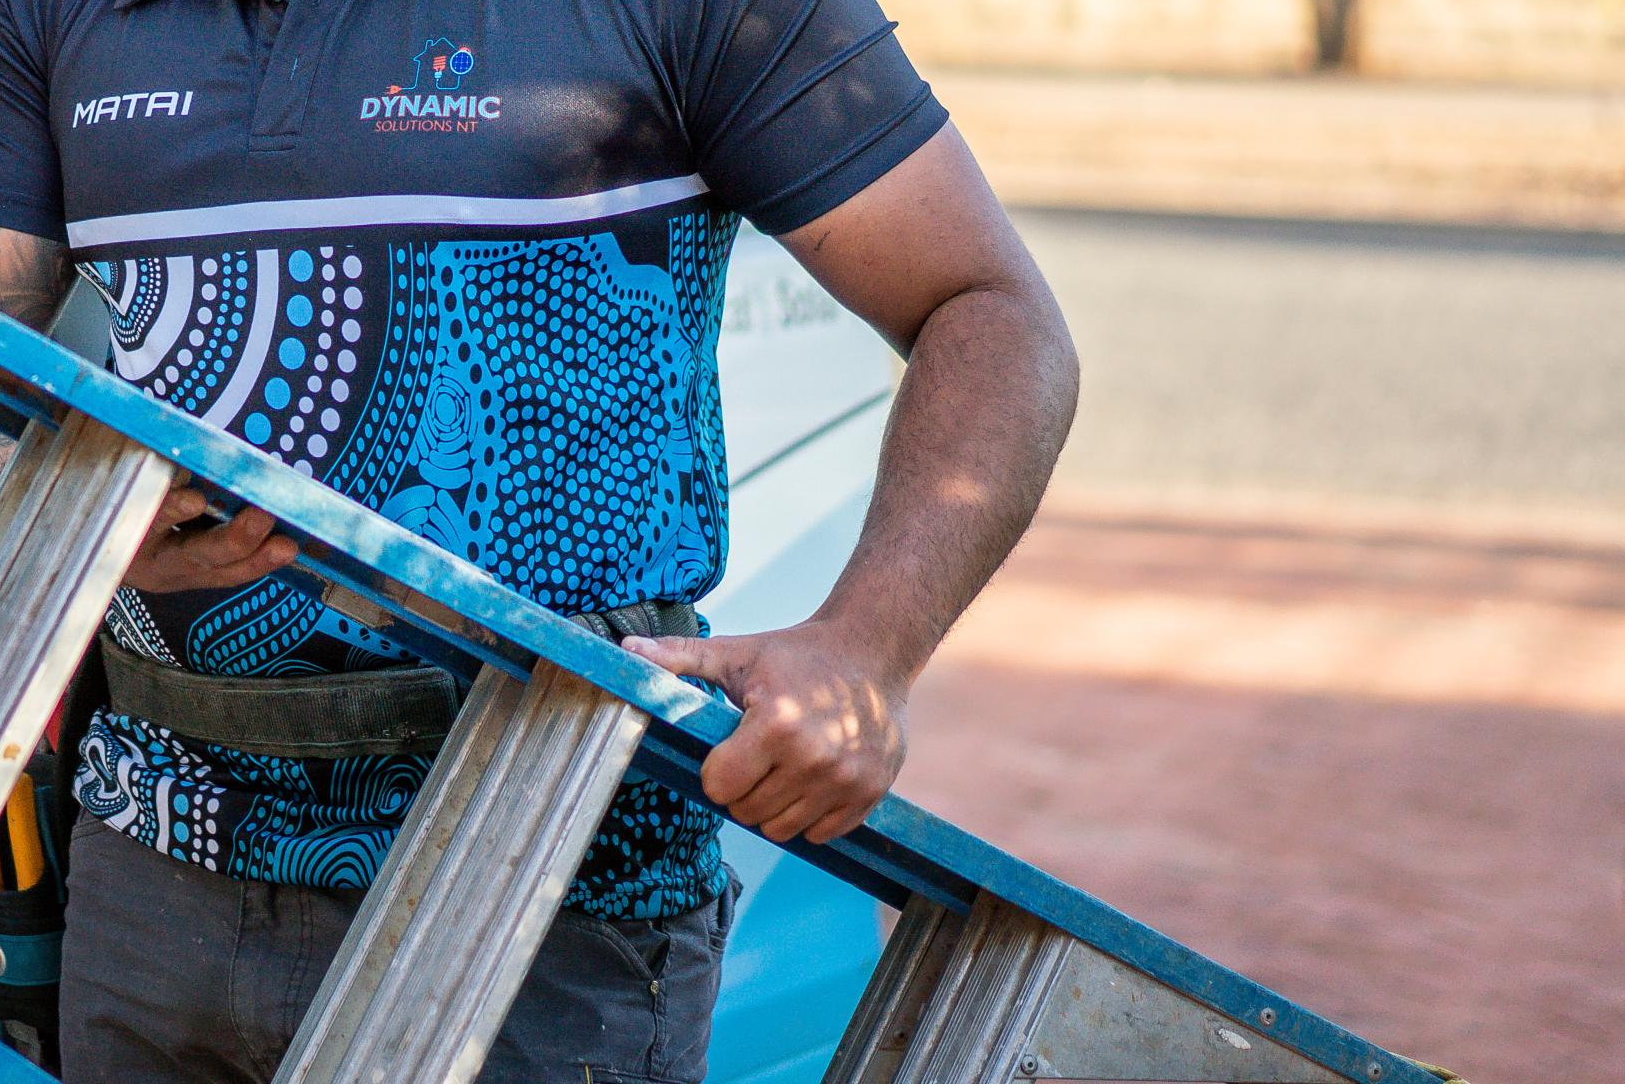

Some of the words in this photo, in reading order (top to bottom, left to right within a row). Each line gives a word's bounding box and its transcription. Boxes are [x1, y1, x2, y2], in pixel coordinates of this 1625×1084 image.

[72, 91, 193, 129] MATAI
[360, 94, 501, 120] DYNAMIC
[375, 119, 453, 133] SOLUTIONS
[456, 120, 479, 133] NT
